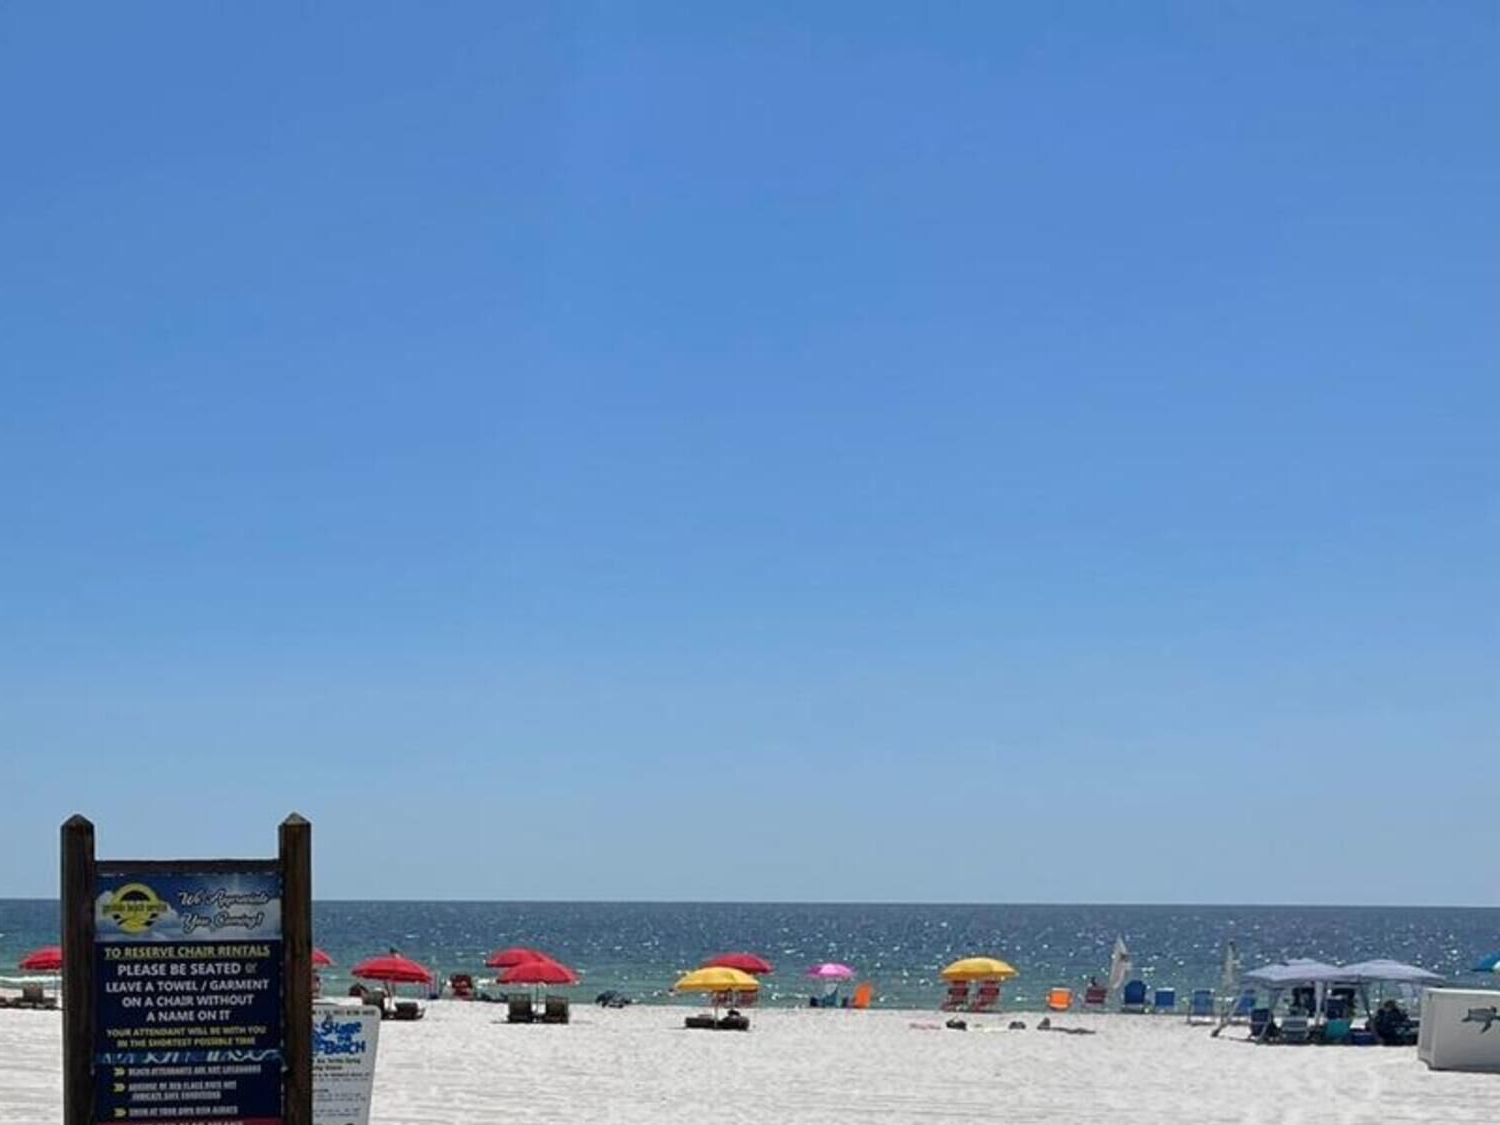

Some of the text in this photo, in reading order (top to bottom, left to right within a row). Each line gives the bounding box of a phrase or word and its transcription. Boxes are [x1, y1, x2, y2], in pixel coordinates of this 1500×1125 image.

[178, 888, 269, 908] We Appreciate
[181, 911, 265, 934] You Coming!
[105, 945, 270, 958] TO RESERVE CHAIR RENTALS
[118, 963, 166, 976] PLEASE
[170, 963, 186, 976] BE
[190, 962, 241, 975] SEATED
[106, 979, 269, 993] LEAVE A TOWEL / GARMENT
[122, 994, 254, 1007] ON A CHAIR WITHOUT
[146, 1010, 231, 1022] A NAME ON IT
[107, 1025, 267, 1037] YOUR ATTENDANT WILL BE WITH YOU
[117, 1037, 256, 1048] IN THE SHORTEST POSSIBLE TIME
